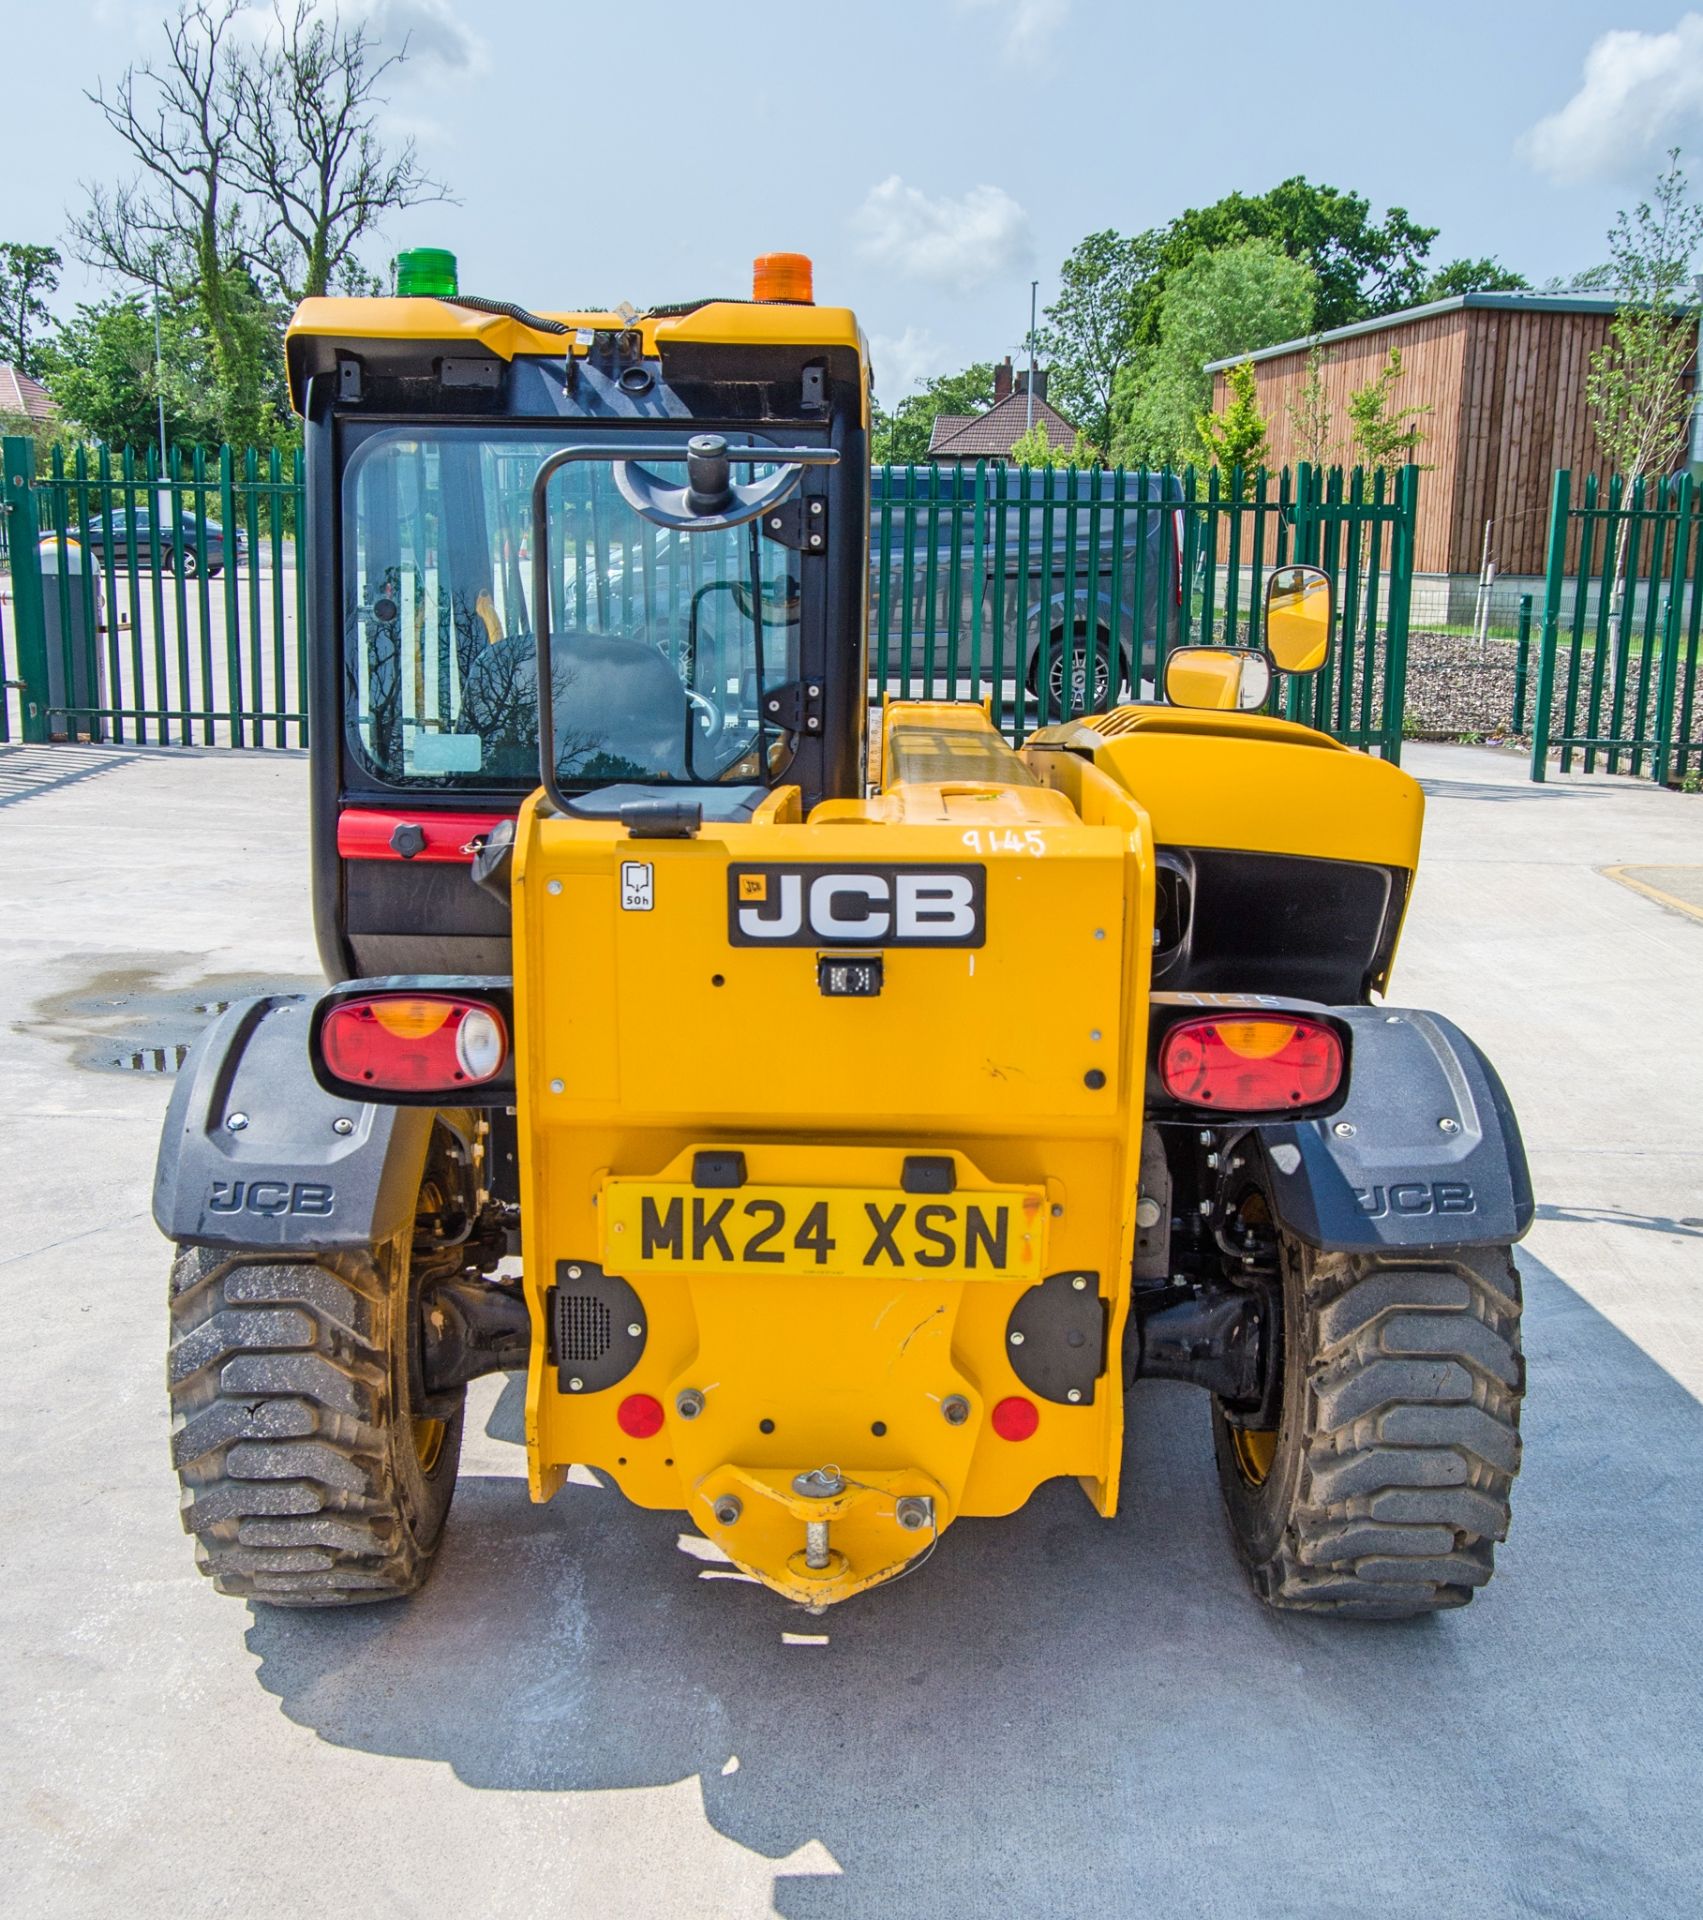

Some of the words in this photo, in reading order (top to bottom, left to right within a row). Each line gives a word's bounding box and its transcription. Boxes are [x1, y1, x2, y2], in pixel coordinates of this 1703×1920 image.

[962, 830, 1046, 857] 9145
[737, 874, 976, 939] JCB
[209, 1180, 335, 1217] JCB
[1350, 1181, 1476, 1218] JCB
[640, 1196, 836, 1264] MK24
[863, 1203, 1009, 1269] XSN
